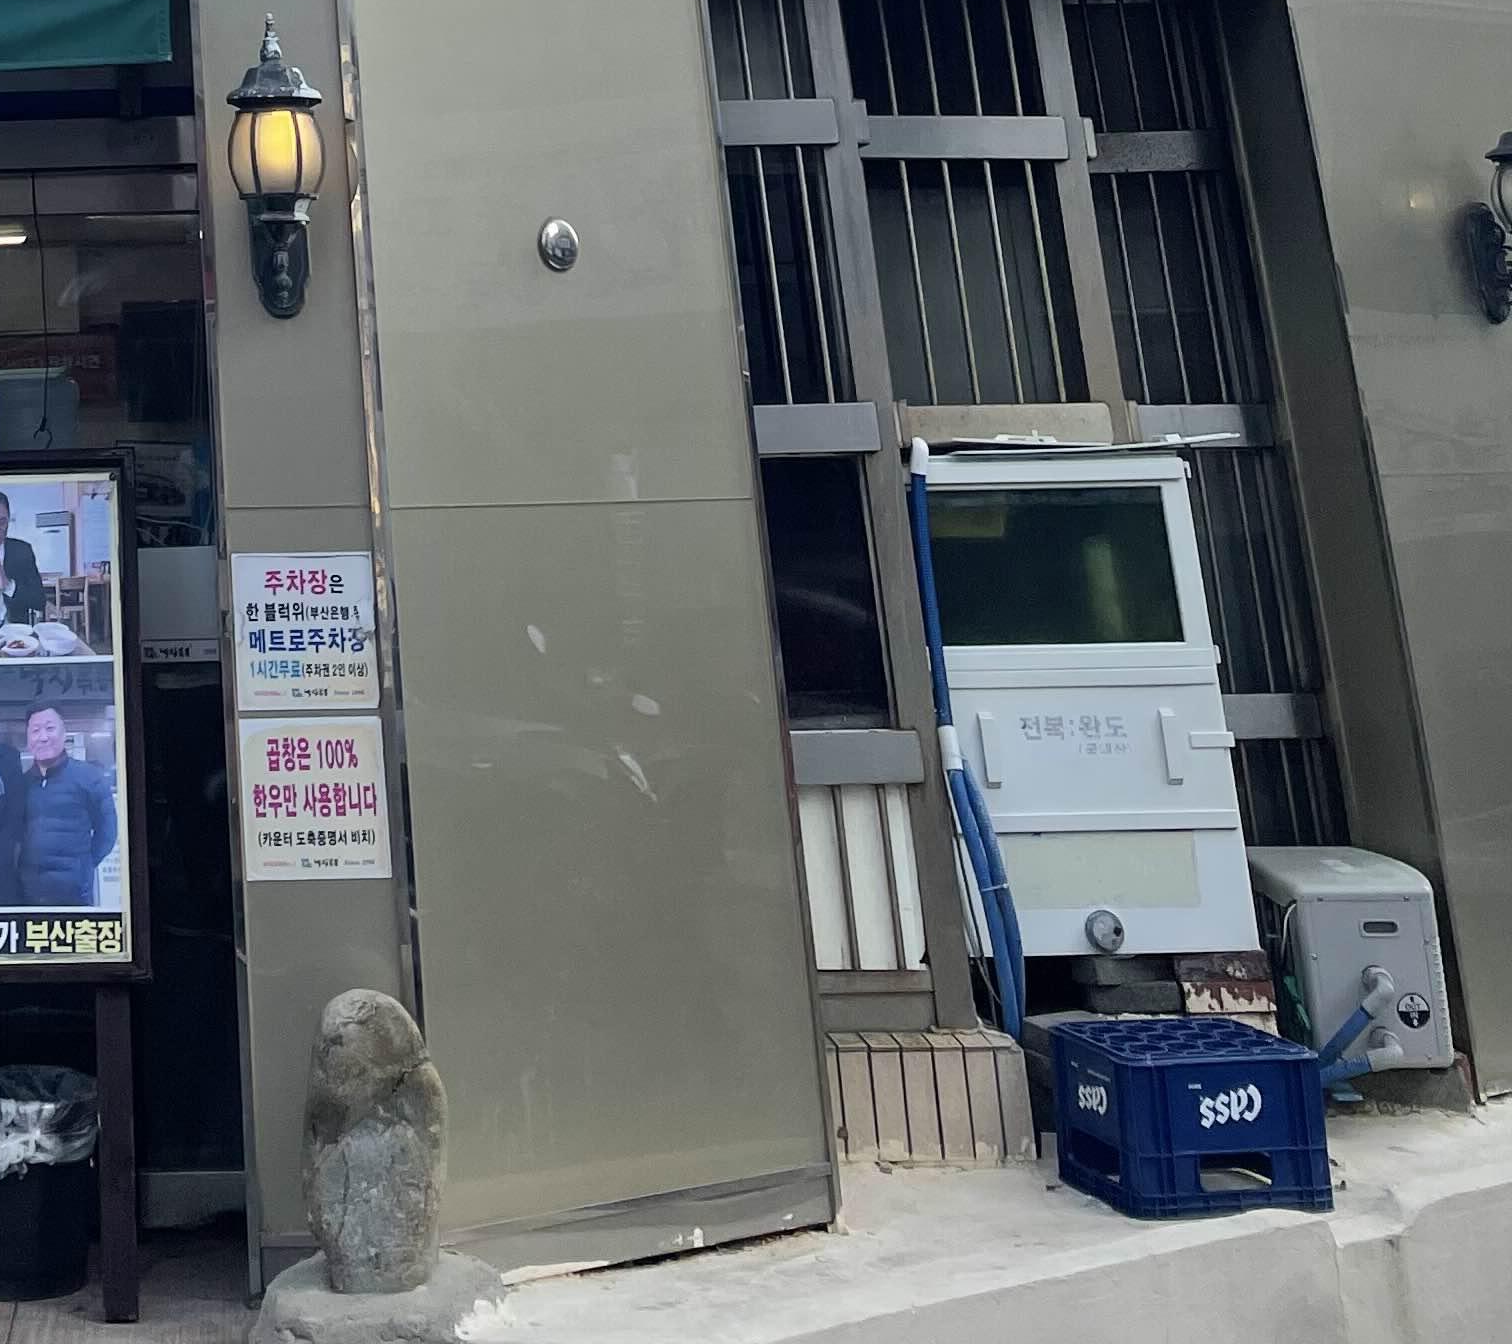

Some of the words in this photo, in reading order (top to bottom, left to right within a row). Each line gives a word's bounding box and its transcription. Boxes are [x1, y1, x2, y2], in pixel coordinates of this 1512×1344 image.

[264, 569, 345, 596] 주차장은
[266, 737, 312, 772] 곱창은
[315, 738, 360, 769] 100%
[252, 782, 298, 819] 한우만
[303, 781, 378, 819] 사용합니다
[25, 917, 122, 954] 부산출장
